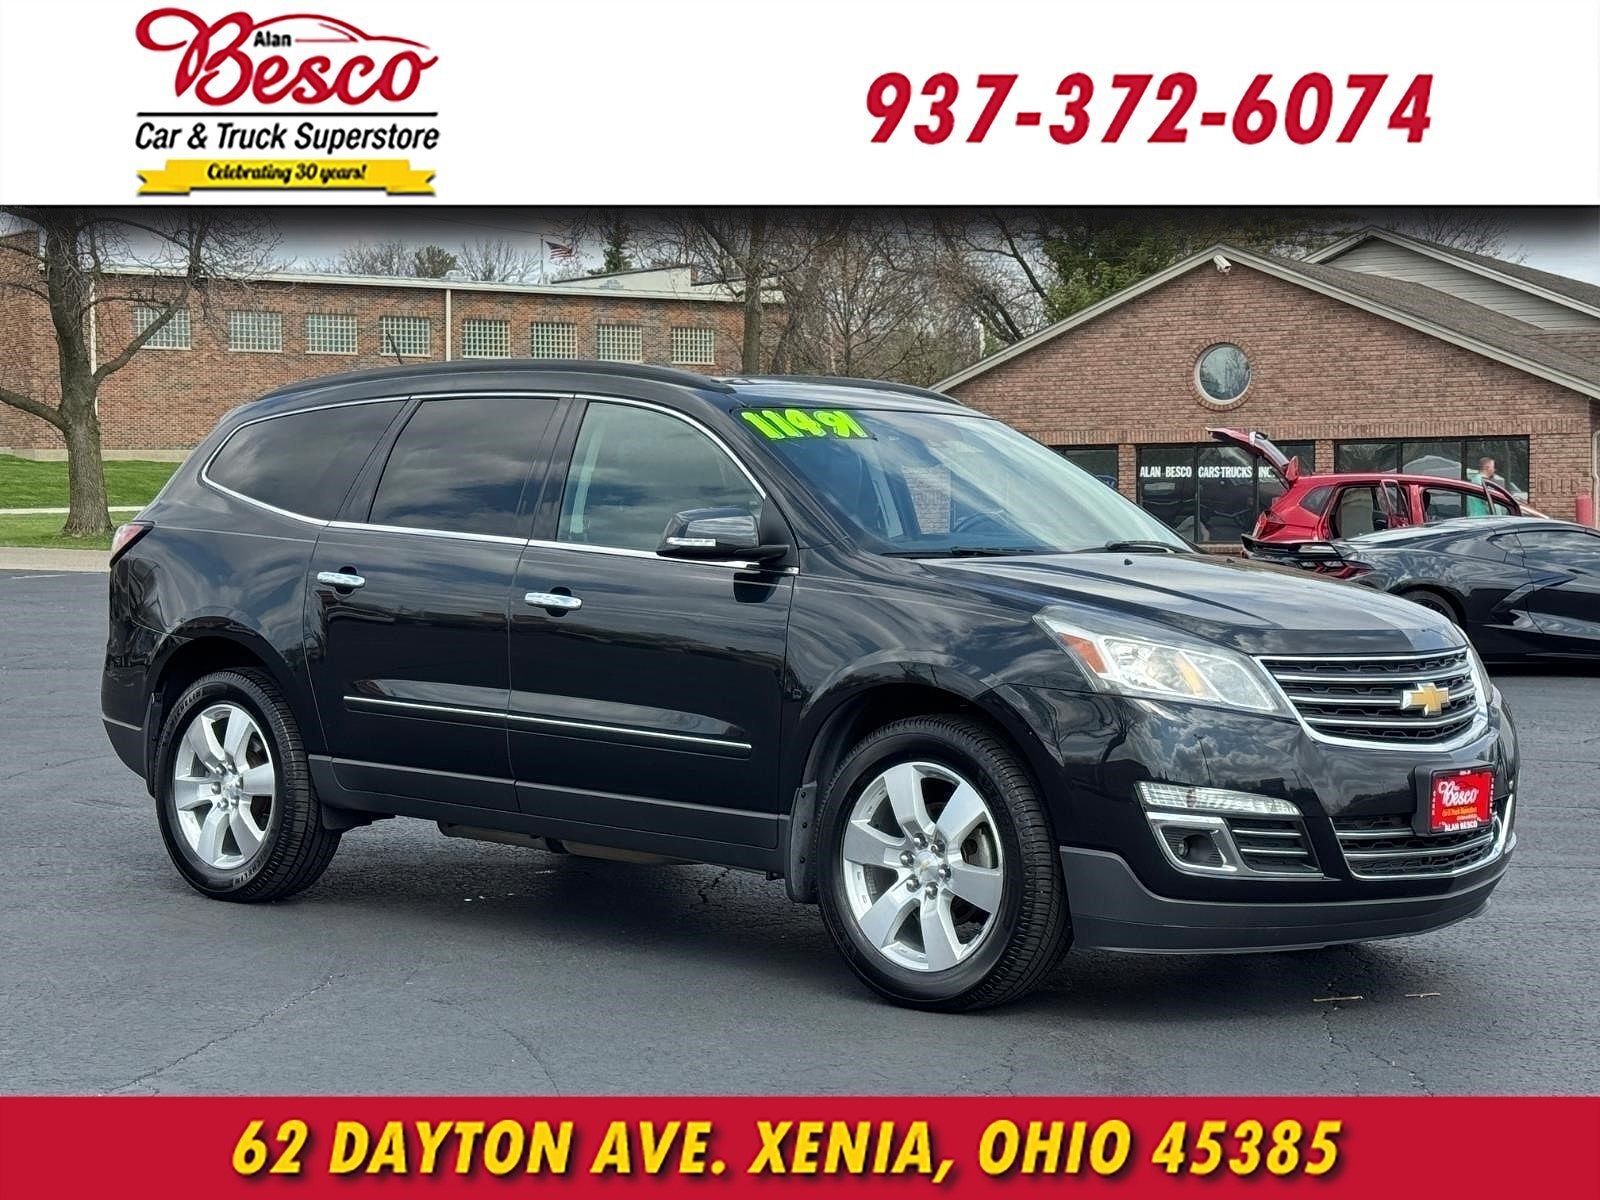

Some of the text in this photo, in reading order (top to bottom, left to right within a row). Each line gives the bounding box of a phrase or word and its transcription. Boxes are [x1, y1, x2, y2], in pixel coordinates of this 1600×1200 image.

[1139, 466, 1162, 478] ALAN
[1165, 466, 1192, 478] BESCO
[1438, 781, 1479, 806] Besco
